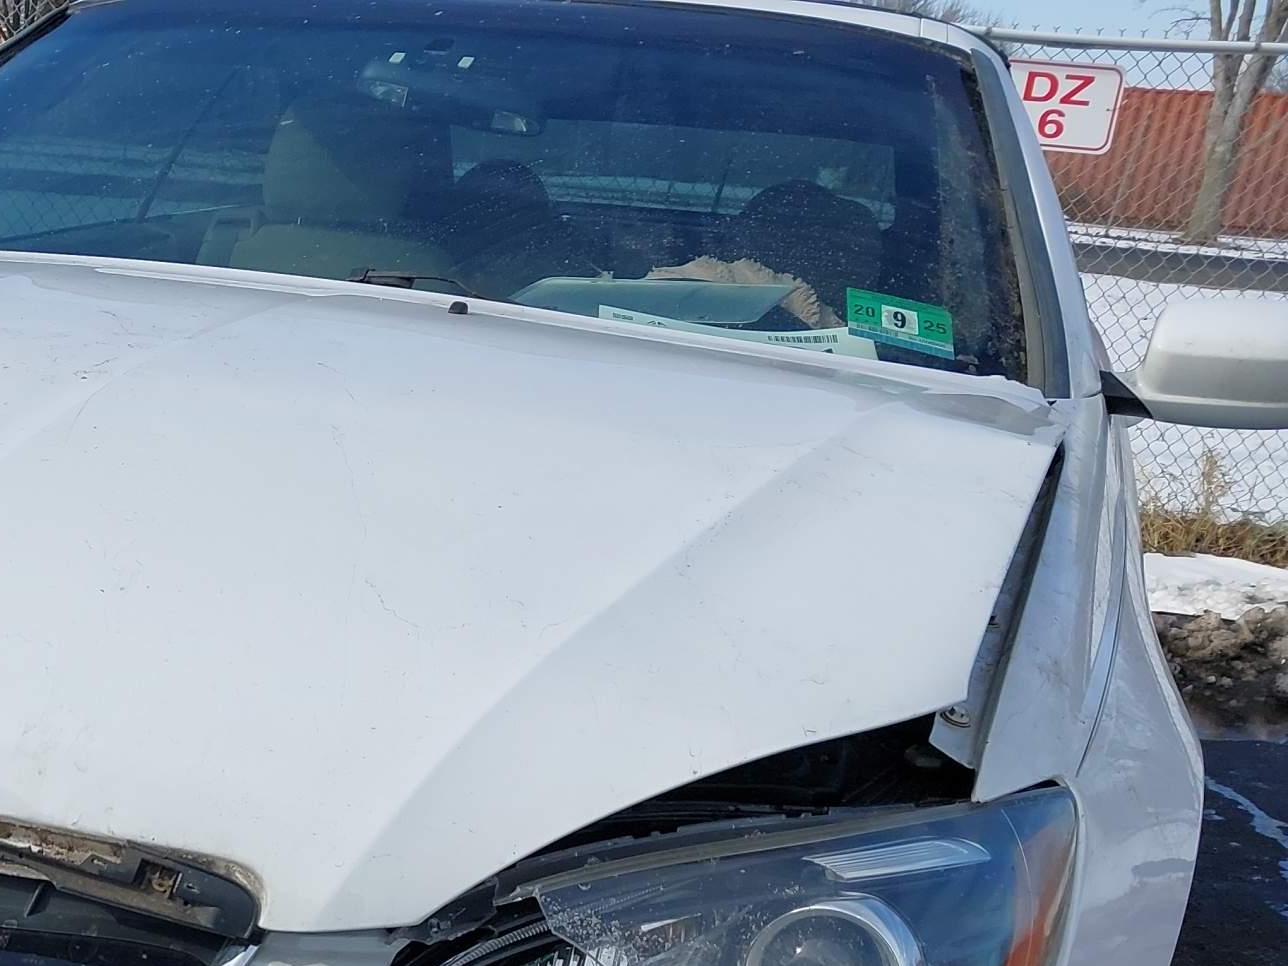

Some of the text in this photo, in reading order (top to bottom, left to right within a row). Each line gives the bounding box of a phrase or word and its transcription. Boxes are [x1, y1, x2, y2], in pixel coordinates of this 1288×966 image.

[1022, 71, 1096, 107] DZ
[1037, 108, 1066, 139] 6
[854, 303, 947, 335] 20 9 25
